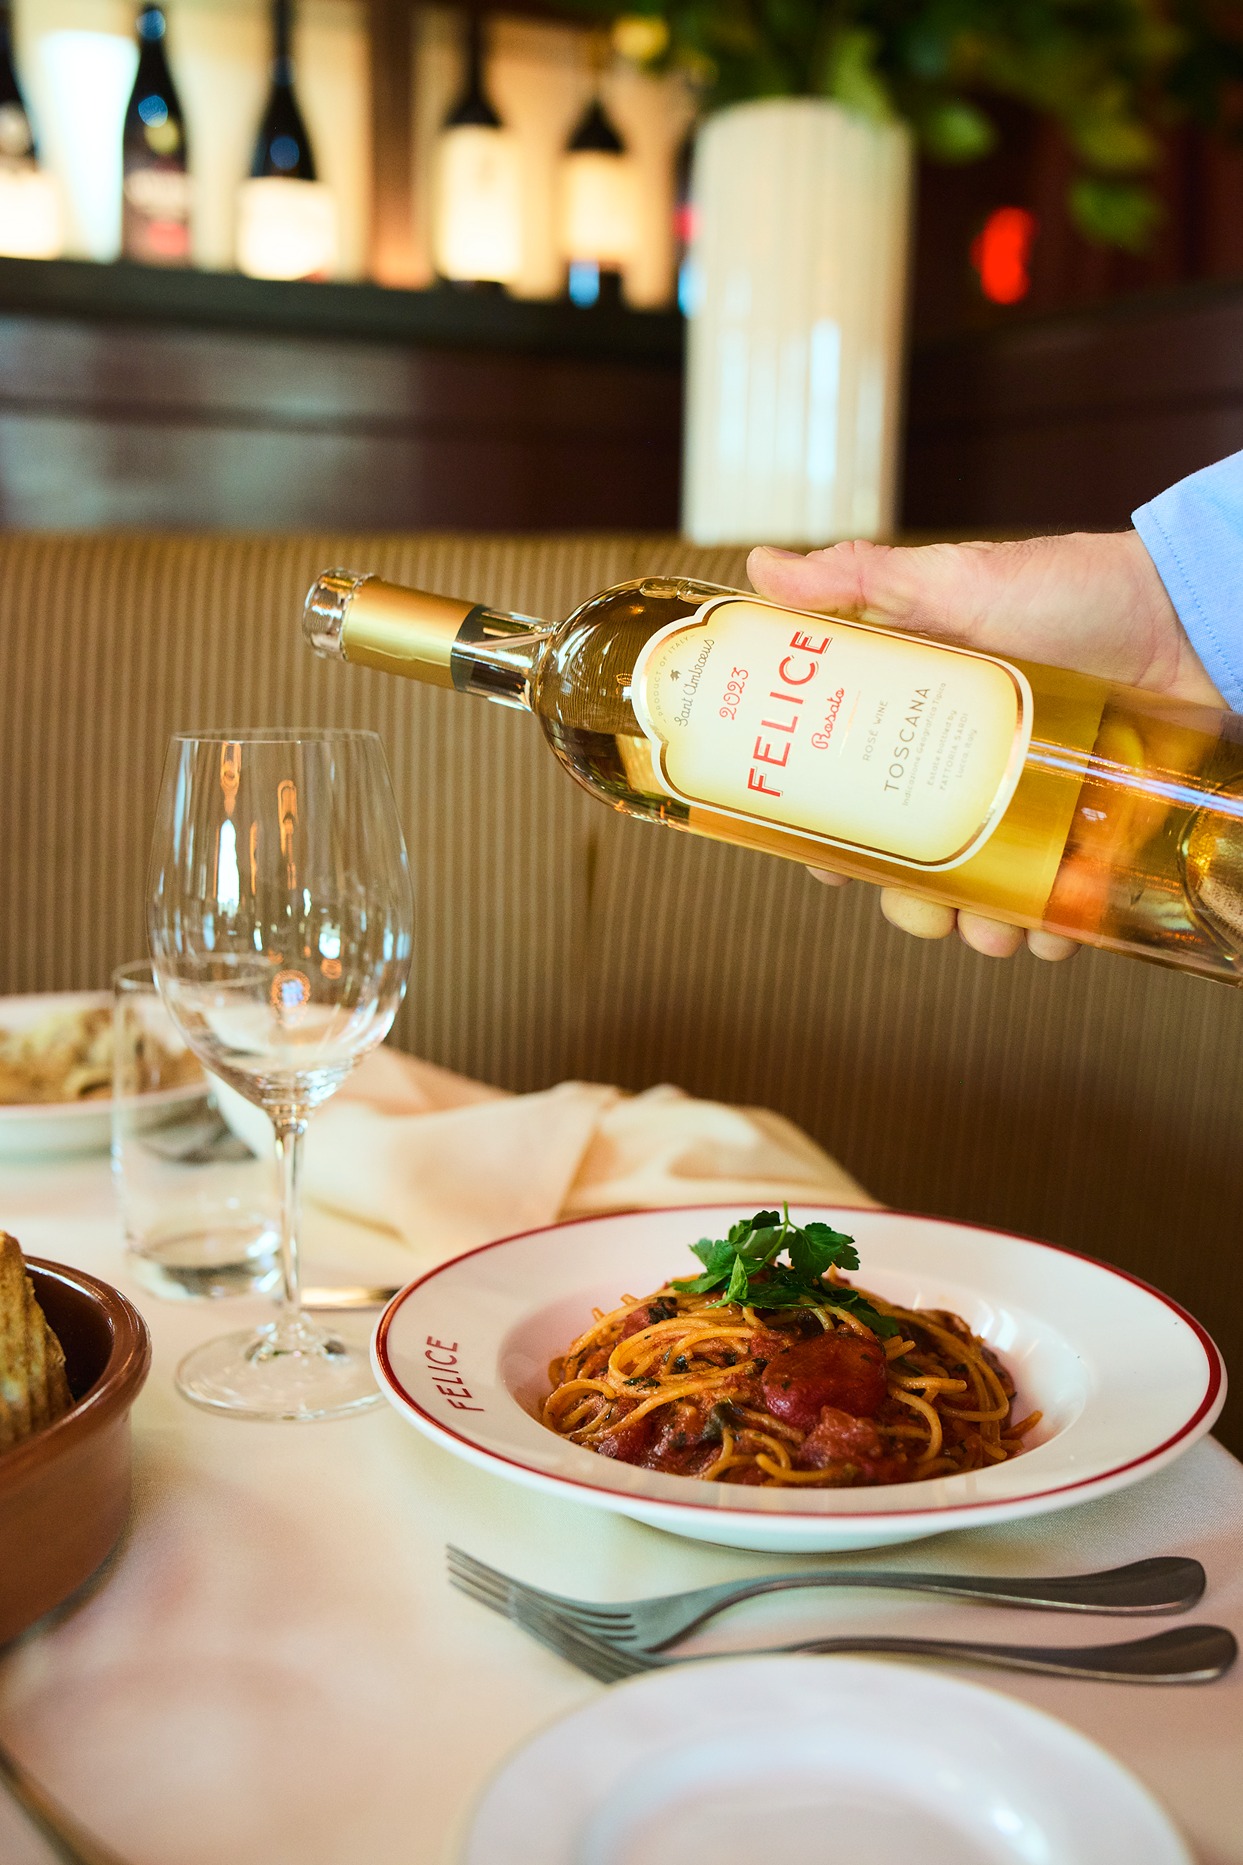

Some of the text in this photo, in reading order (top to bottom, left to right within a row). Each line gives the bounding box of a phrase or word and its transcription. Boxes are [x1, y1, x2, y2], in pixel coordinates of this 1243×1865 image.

[668, 635, 690, 654] ITALY
[674, 697, 694, 727] Sant
[719, 667, 749, 721] 2023
[747, 631, 833, 798] FELICE
[811, 688, 845, 750] Rosato
[873, 700, 888, 726] WINE
[883, 688, 931, 792] TOSCANA
[424, 1335, 486, 1412] FELICE
